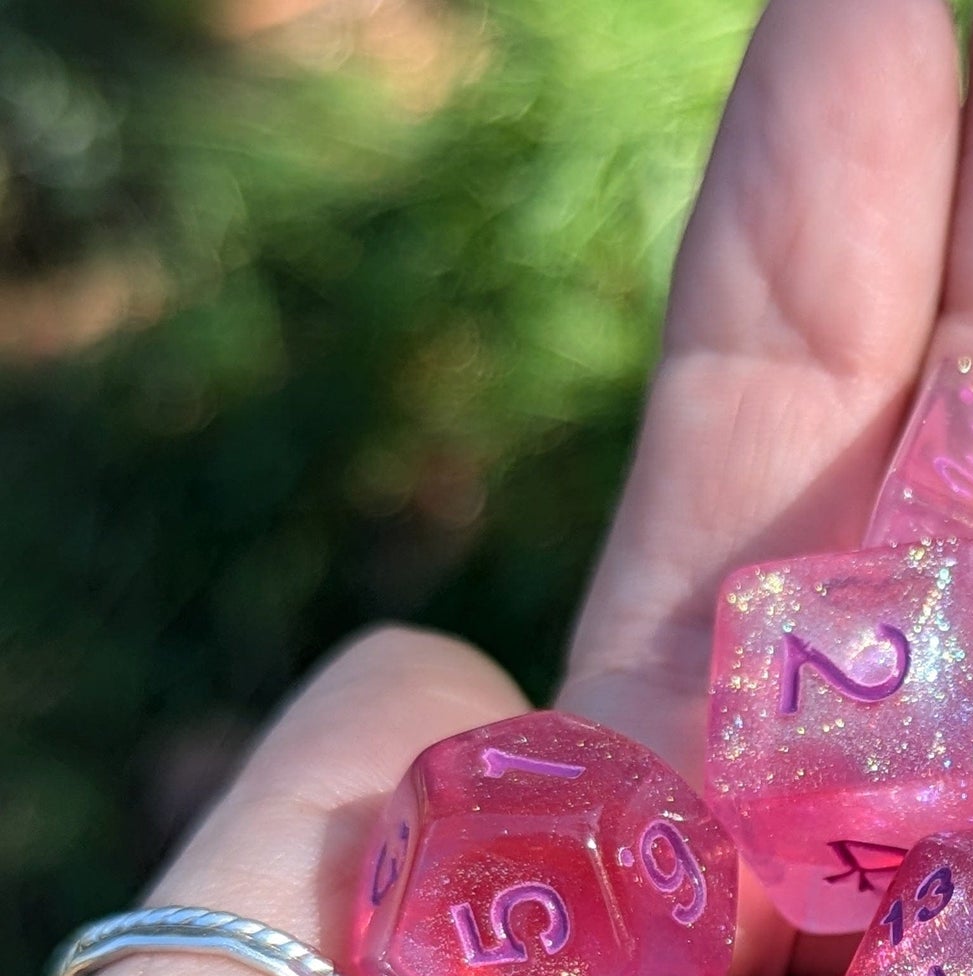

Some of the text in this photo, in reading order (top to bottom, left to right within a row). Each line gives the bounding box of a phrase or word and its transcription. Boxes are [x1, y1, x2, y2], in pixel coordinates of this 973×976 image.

[779, 623, 912, 715] 2
[480, 748, 586, 779] 1
[449, 881, 571, 967] 5
[882, 866, 955, 946] 13
